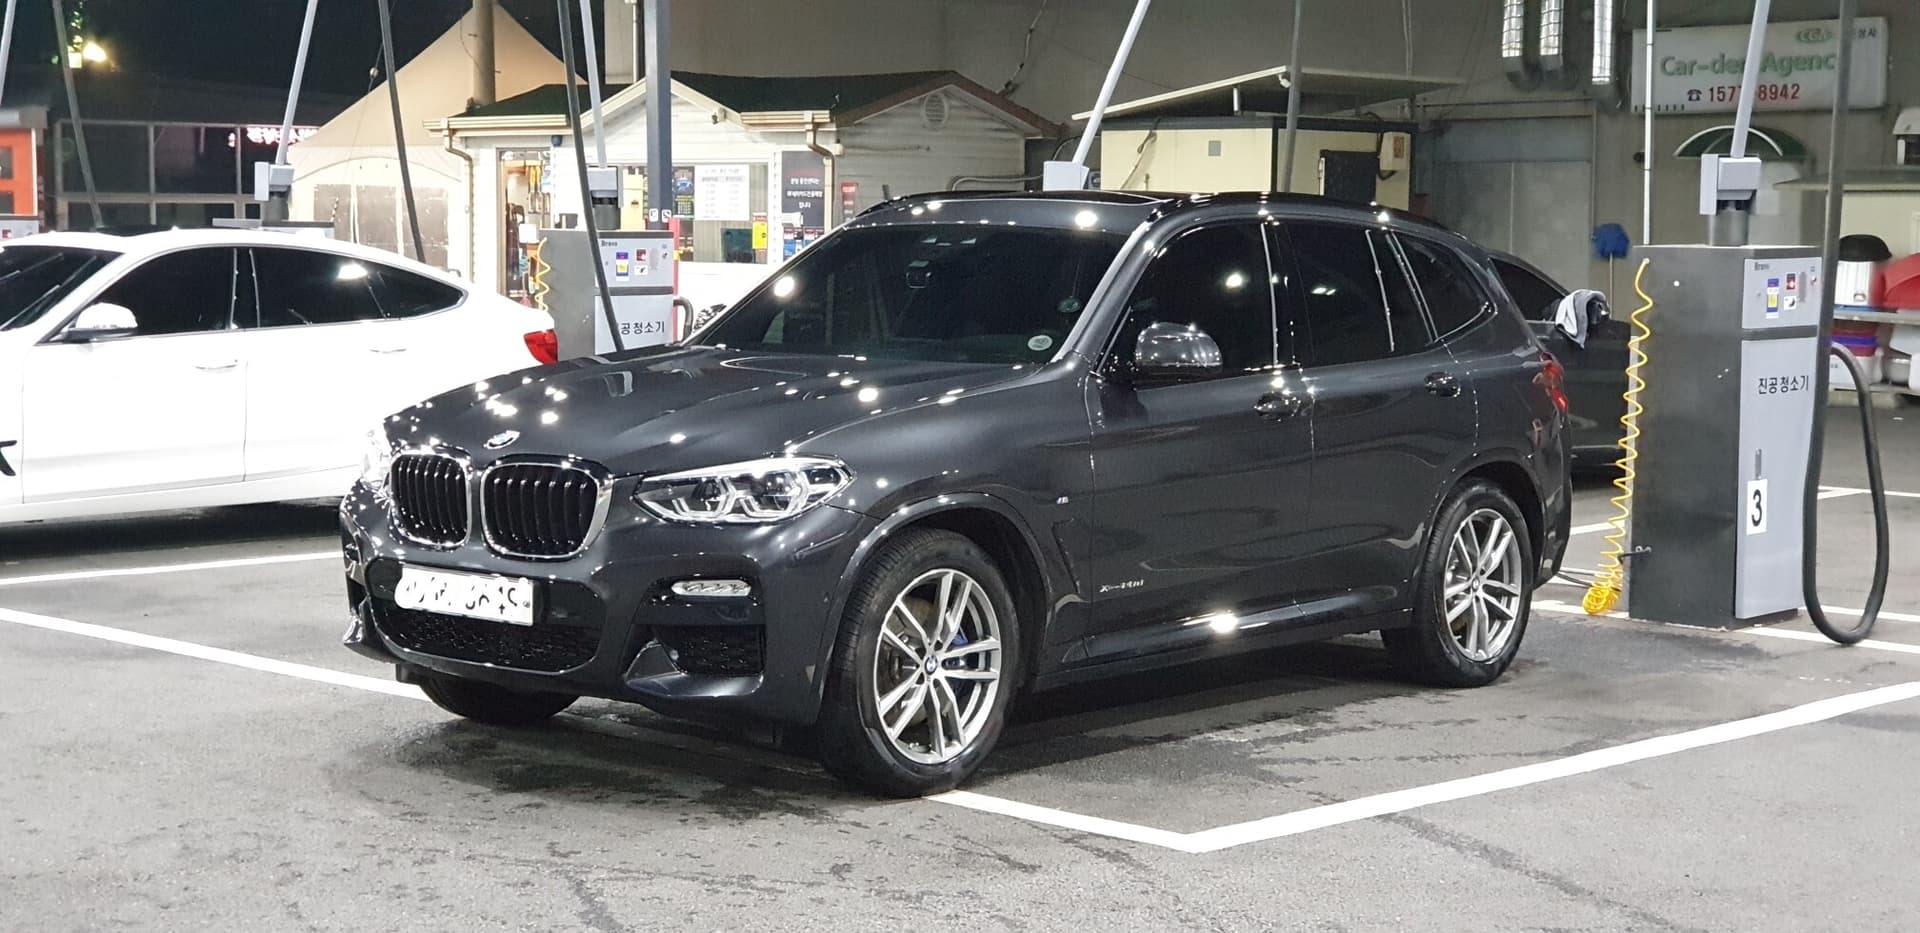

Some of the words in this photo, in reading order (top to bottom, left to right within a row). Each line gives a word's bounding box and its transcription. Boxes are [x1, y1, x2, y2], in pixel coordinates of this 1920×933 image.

[619, 321, 665, 335] 공청소기
[1758, 375, 1809, 395] 진공청소기
[1751, 489, 1762, 527] 3
